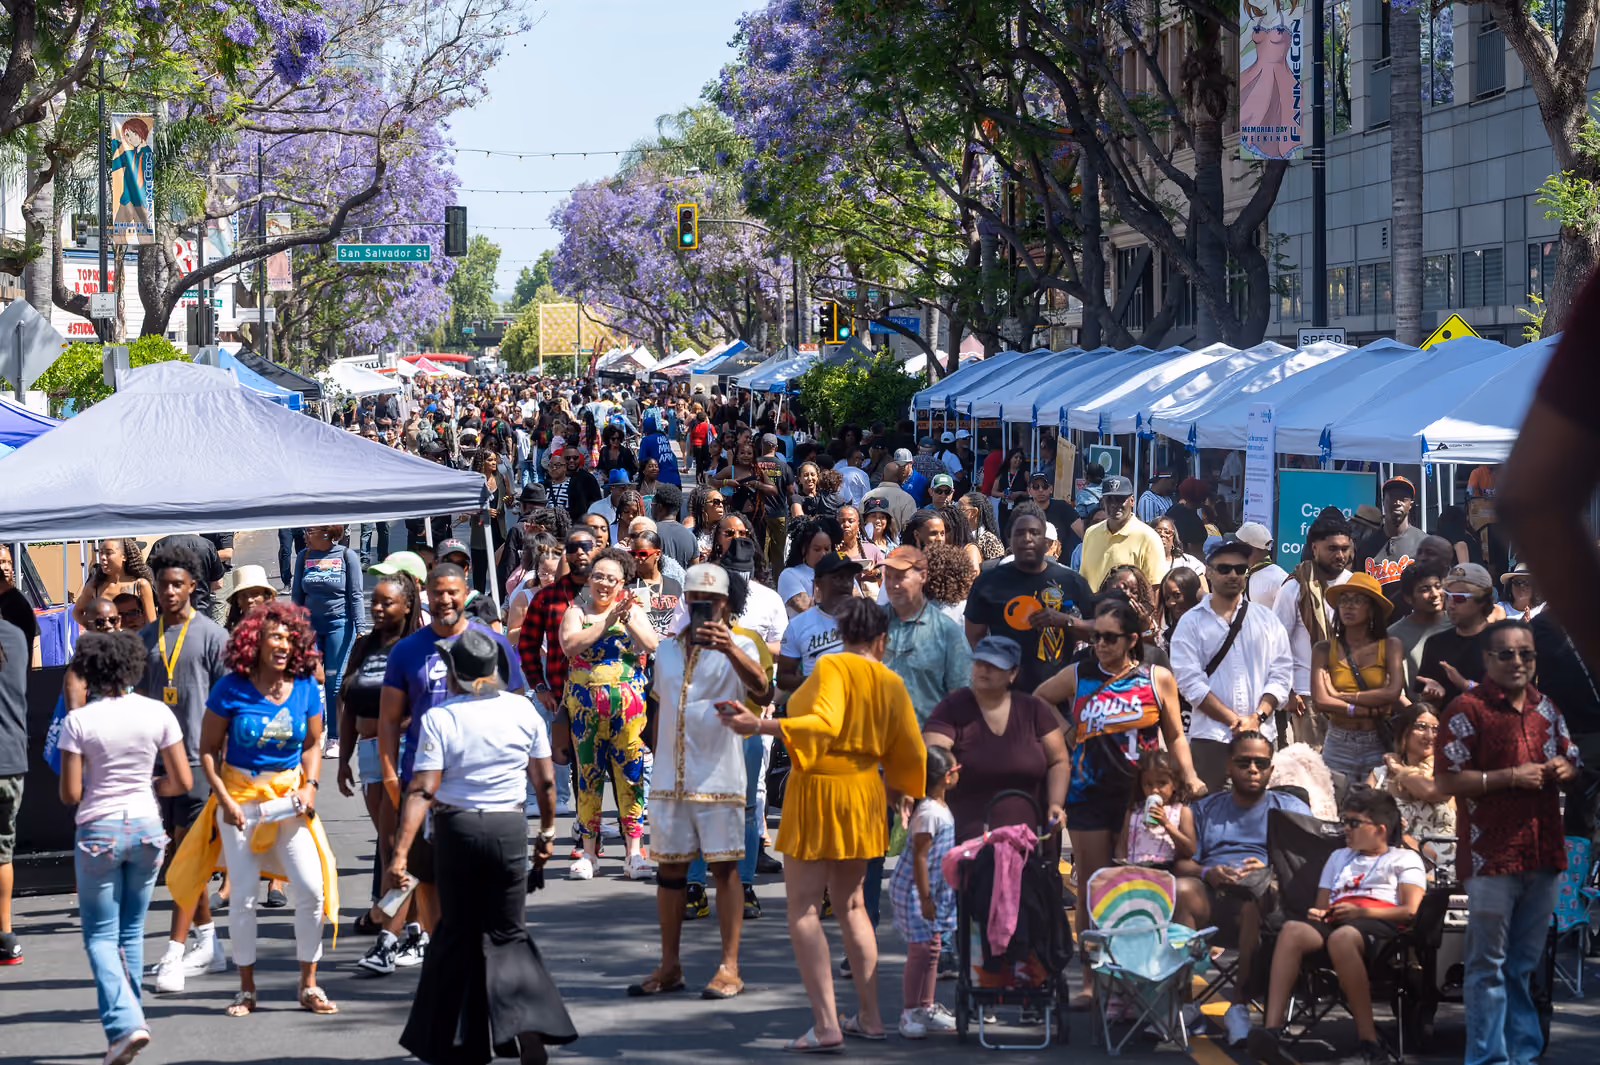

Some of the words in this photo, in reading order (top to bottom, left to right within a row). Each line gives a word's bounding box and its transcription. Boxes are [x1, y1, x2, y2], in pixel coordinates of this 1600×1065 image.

[340, 248, 360, 258] San
[365, 248, 411, 258] Salvador
[416, 248, 427, 258] St
[166, 691, 174, 702] V
[1125, 728, 1139, 761] 1
